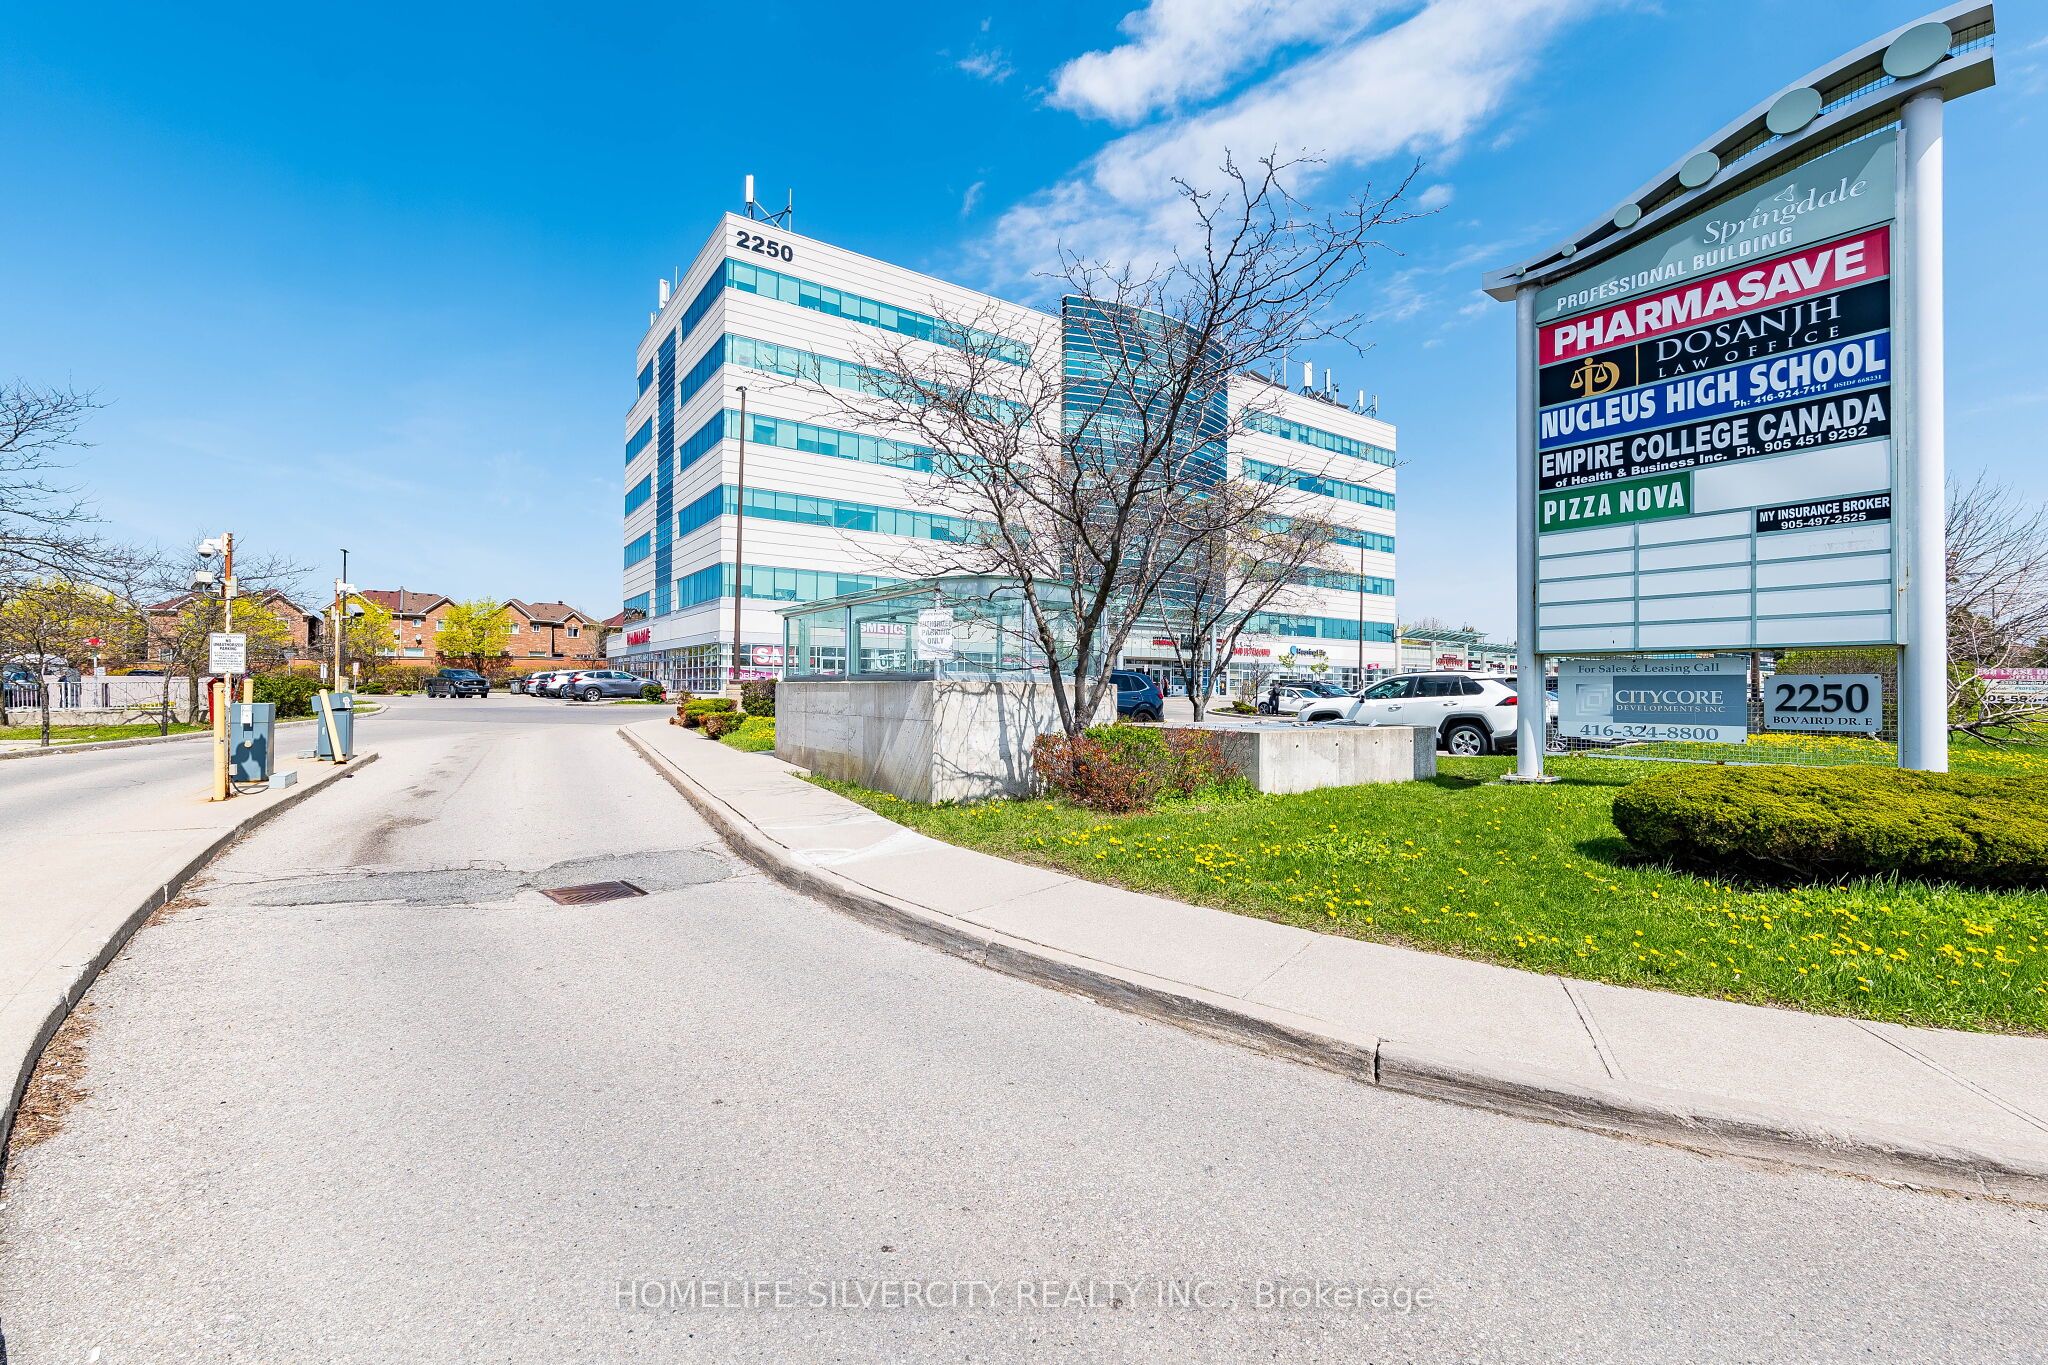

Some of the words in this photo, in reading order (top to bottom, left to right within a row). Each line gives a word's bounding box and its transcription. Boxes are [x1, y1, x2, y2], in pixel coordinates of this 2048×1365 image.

[1703, 176, 1867, 244] Springdale
[736, 230, 794, 262] 2250
[1557, 260, 1687, 312] PROFESSIONAL
[1693, 226, 1793, 271] BUILDING
[1554, 240, 1867, 356] PHARMASAVE
[1656, 295, 1841, 362] DOSANJH
[1658, 356, 1710, 378] LAW
[1725, 325, 1840, 362] OFFICE
[1541, 388, 1656, 440] NUCLEUS
[1666, 370, 1738, 414] HIGH
[1750, 339, 1886, 397] SCHOOL
[1733, 399, 1751, 408] Ph:
[1754, 382, 1828, 405] 416-924-7111
[1542, 441, 1624, 478] EMPIRE
[1631, 417, 1749, 463] COLLEGE
[1757, 393, 1887, 442] CANADA
[1555, 478, 1568, 488] of
[1571, 470, 1613, 485] Health
[1616, 468, 1627, 478] &
[1631, 458, 1695, 476] Business
[1699, 450, 1728, 464] Inc.
[1736, 445, 1760, 457] Ph.
[1764, 439, 1792, 452] 905
[1795, 433, 1822, 447] 451
[1828, 425, 1868, 442] 9292
[1543, 493, 1612, 525] PIZZA
[1619, 481, 1685, 514] NOVA
[1759, 510, 1776, 523] MY
[1777, 502, 1840, 520] INSURANCE
[1842, 496, 1890, 513] BROKER
[1780, 512, 1867, 530] 905-497-2525
[1578, 665, 1596, 673] For
[1598, 664, 1627, 673] Sales
[1630, 664, 1641, 673] &
[1644, 663, 1690, 674] Leasing
[1693, 662, 1720, 672] Call
[1614, 689, 1724, 705] CITYCORE
[1616, 704, 1701, 713] DEVELOPMENTS
[1774, 683, 1869, 714] 2250
[1579, 724, 1719, 741] 416-324-8800
[1773, 716, 1834, 725] BOVAIRD
[1838, 717, 1861, 726] DR.
[1865, 717, 1873, 726] E
